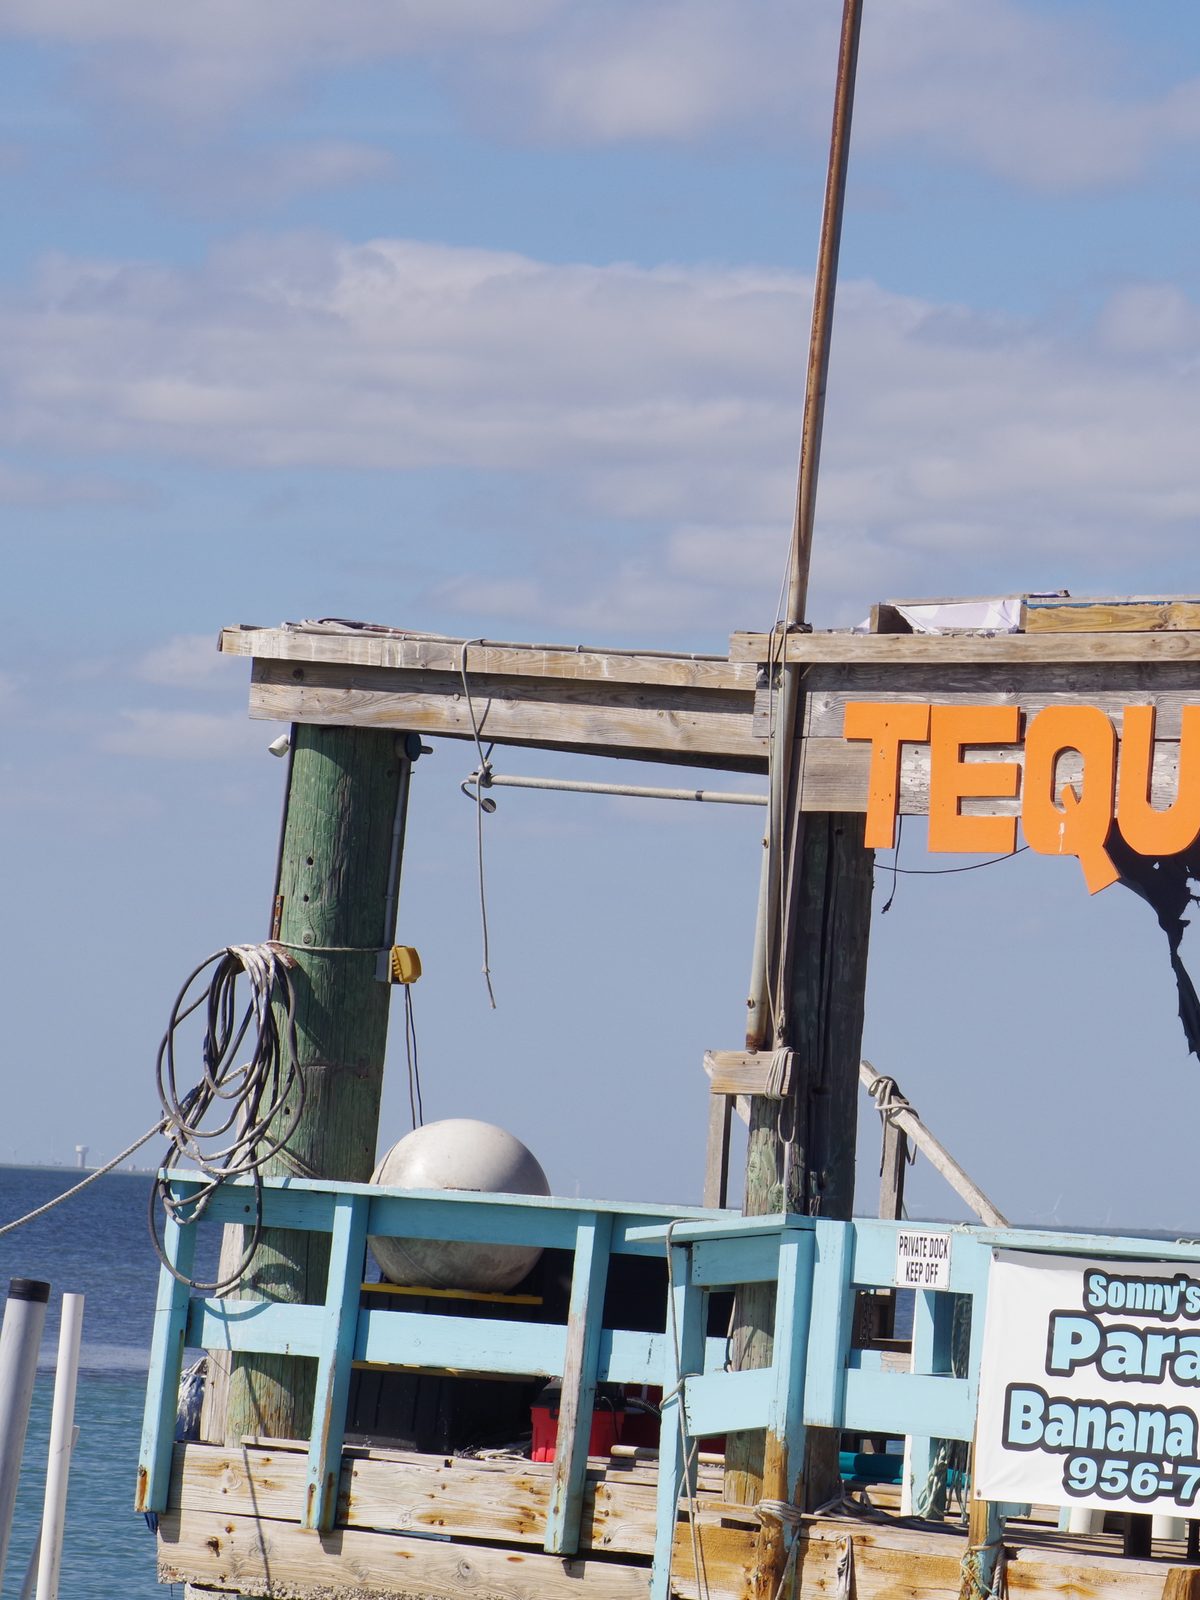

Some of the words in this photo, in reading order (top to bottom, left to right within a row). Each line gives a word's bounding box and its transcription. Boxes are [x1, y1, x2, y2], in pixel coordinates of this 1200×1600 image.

[898, 1235, 928, 1258] PRIVATE
[928, 1237, 949, 1260] DOCK
[905, 1261, 924, 1283] KEEP
[924, 1262, 939, 1284] OFF
[1007, 1389, 1194, 1458] Banana
